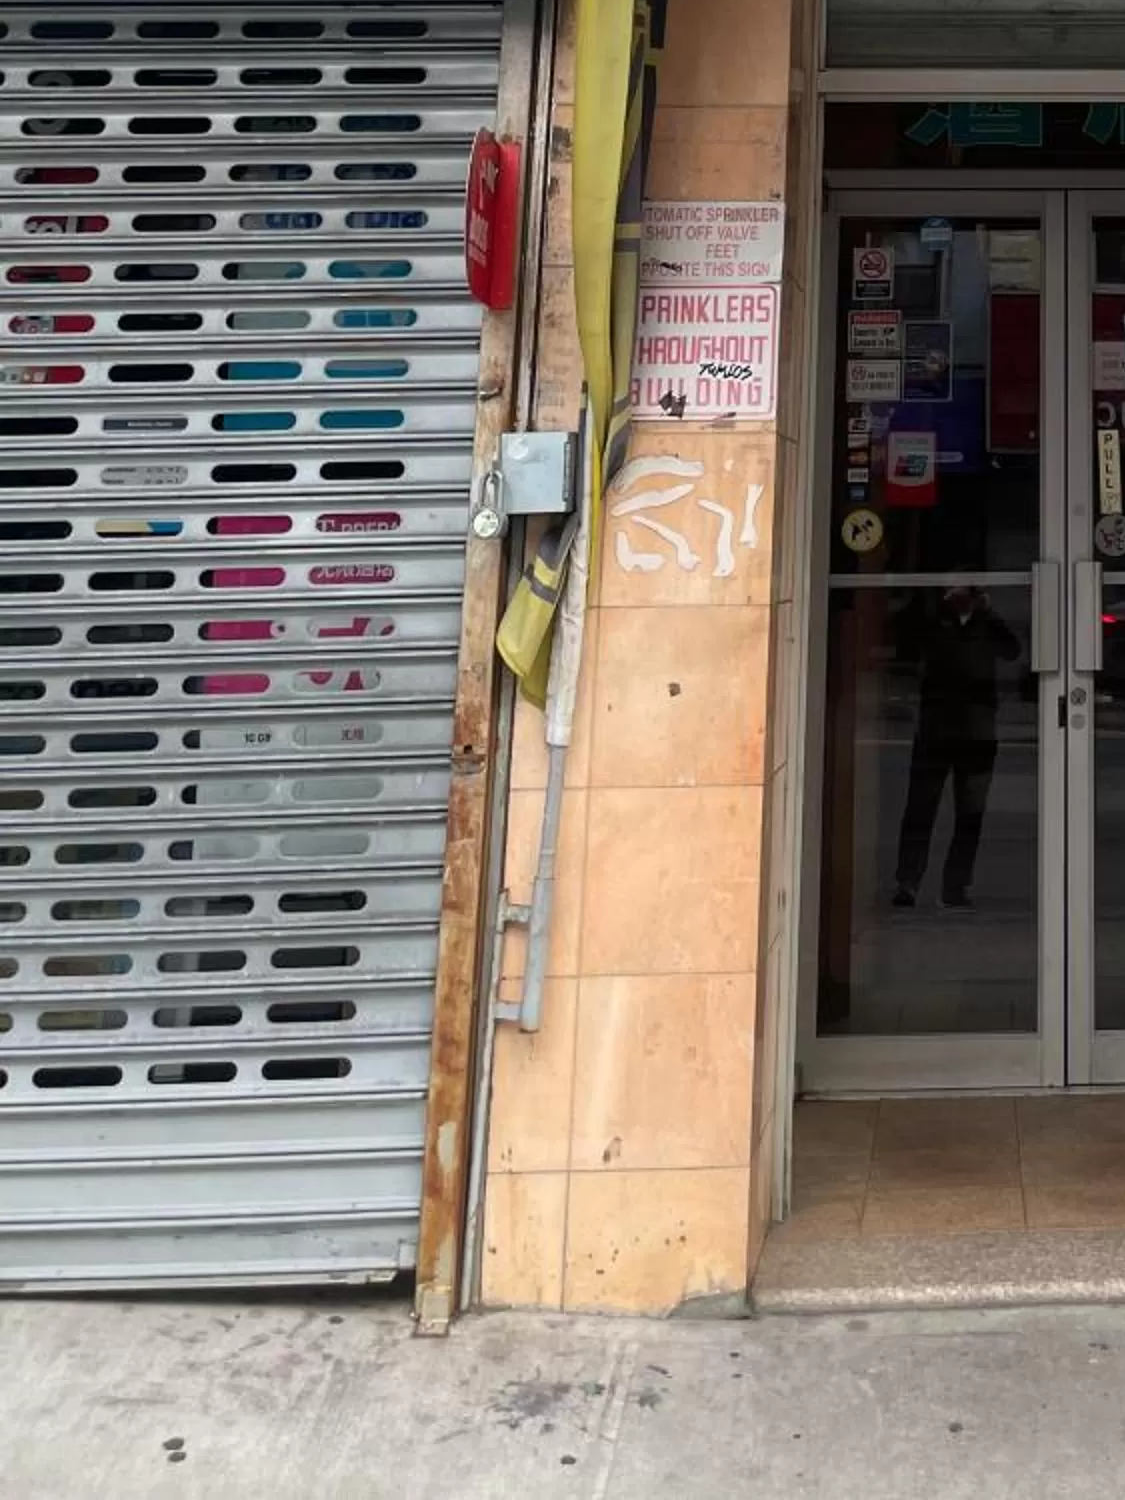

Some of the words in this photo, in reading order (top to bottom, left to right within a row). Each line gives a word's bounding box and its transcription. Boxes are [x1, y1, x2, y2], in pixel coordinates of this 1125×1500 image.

[706, 207, 779, 222] SPRINKLER
[645, 225, 683, 241] SHUT
[686, 225, 713, 241] OFF
[717, 225, 760, 241] VALVE
[705, 243, 740, 259] FEET
[703, 261, 734, 277] THIS
[737, 261, 770, 277] SIGN
